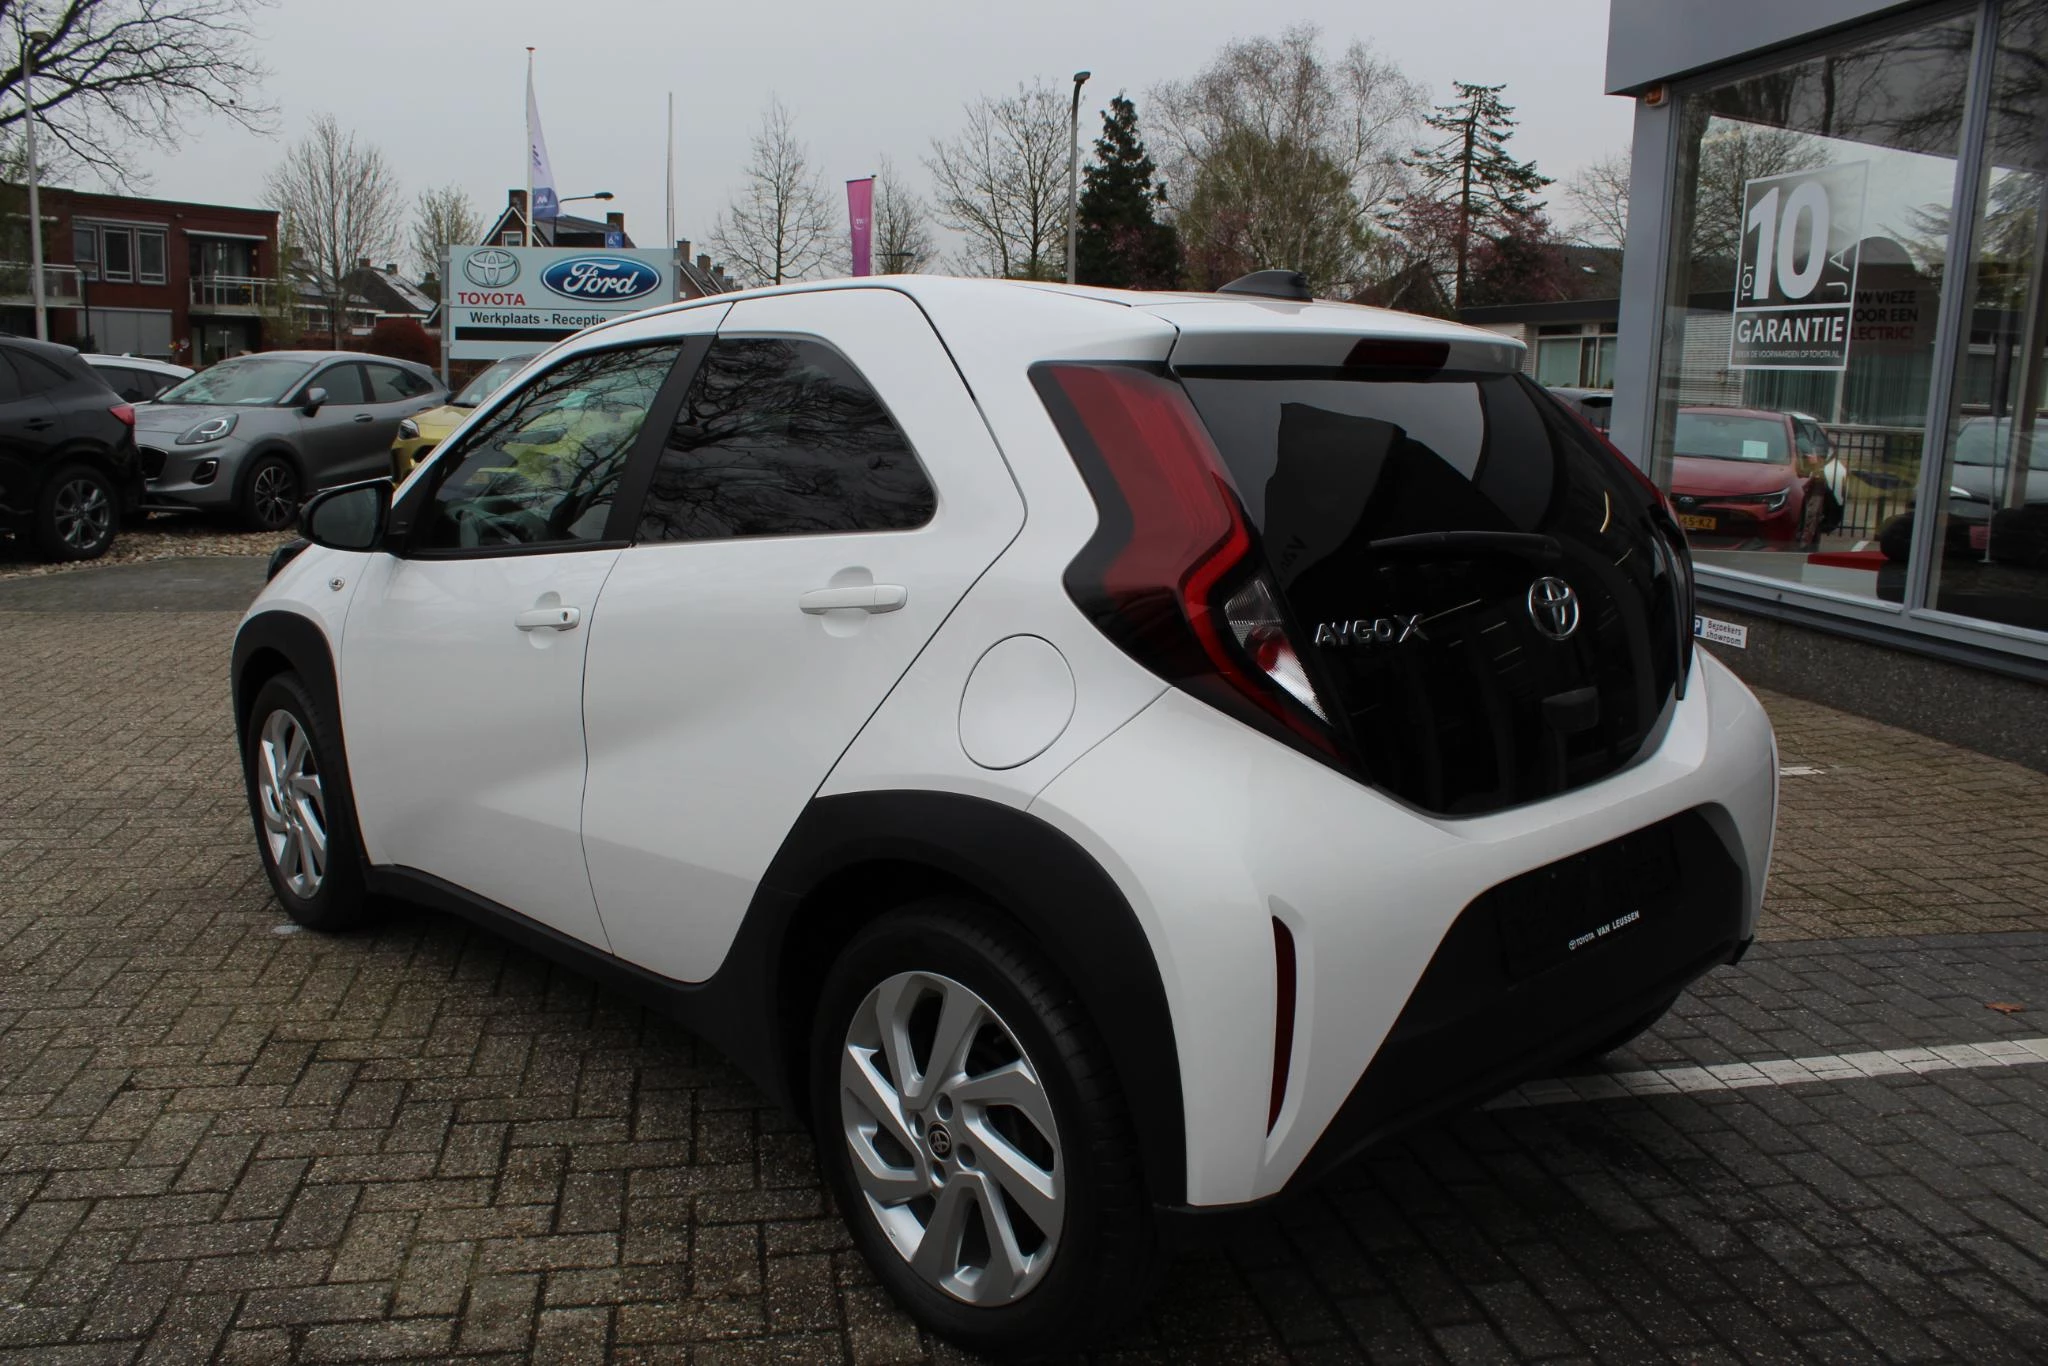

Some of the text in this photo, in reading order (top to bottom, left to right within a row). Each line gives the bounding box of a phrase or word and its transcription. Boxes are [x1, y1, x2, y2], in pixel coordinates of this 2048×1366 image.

[1747, 181, 1830, 301] 10
[1826, 208, 1852, 296] JA
[563, 260, 640, 294] Ford
[1740, 263, 1754, 301] TOT
[458, 292, 526, 306] TOYOTA
[1875, 290, 1916, 304] VIEZE
[470, 312, 540, 326] Werkplaats
[552, 314, 606, 327] Receptie
[1854, 308, 1919, 322] OOR EEN
[1737, 316, 1845, 343] GARANTIE
[1851, 325, 1915, 340] LECTRIC!
[1707, 620, 1742, 636] Bezoekers
[1706, 631, 1742, 646] showroom
[1576, 910, 1640, 946] TOYOTA VAN LEUSSEN
